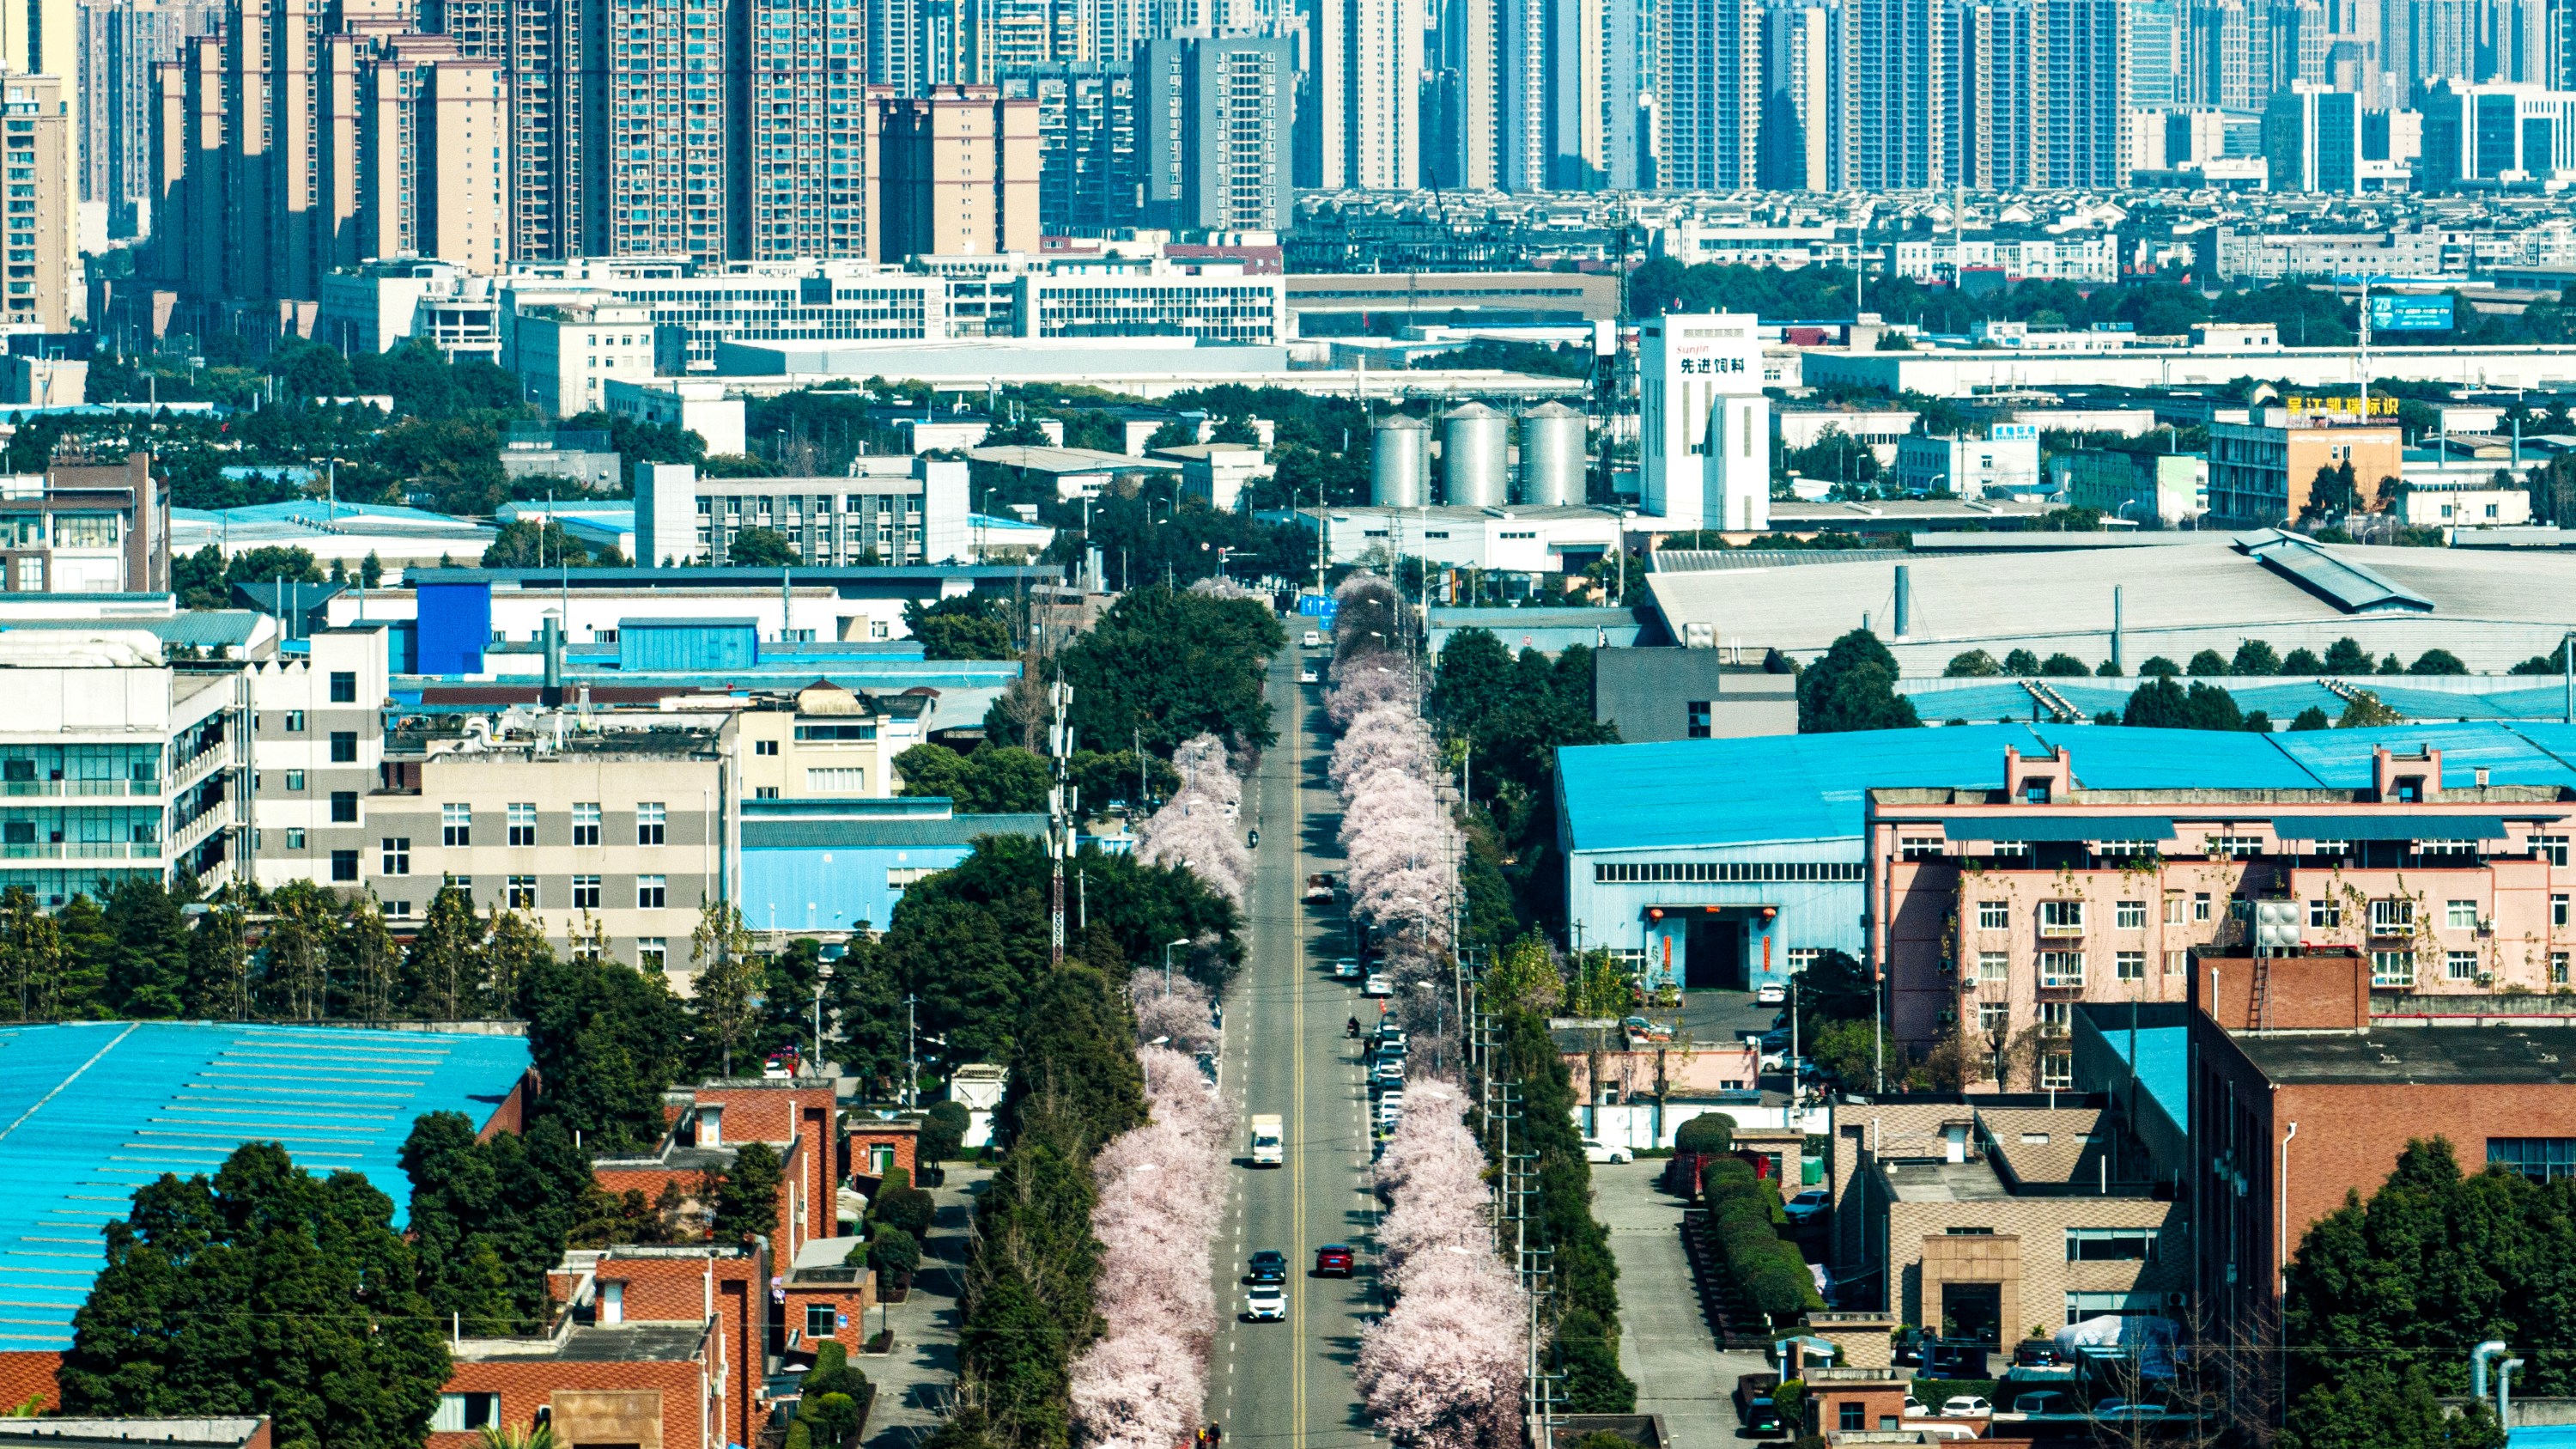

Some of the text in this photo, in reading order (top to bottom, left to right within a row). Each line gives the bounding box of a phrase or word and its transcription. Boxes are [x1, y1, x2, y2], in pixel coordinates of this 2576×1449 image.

[1680, 357, 1745, 374] 先进饲料
[2287, 397, 2399, 415] 吴江凯瑞标识
